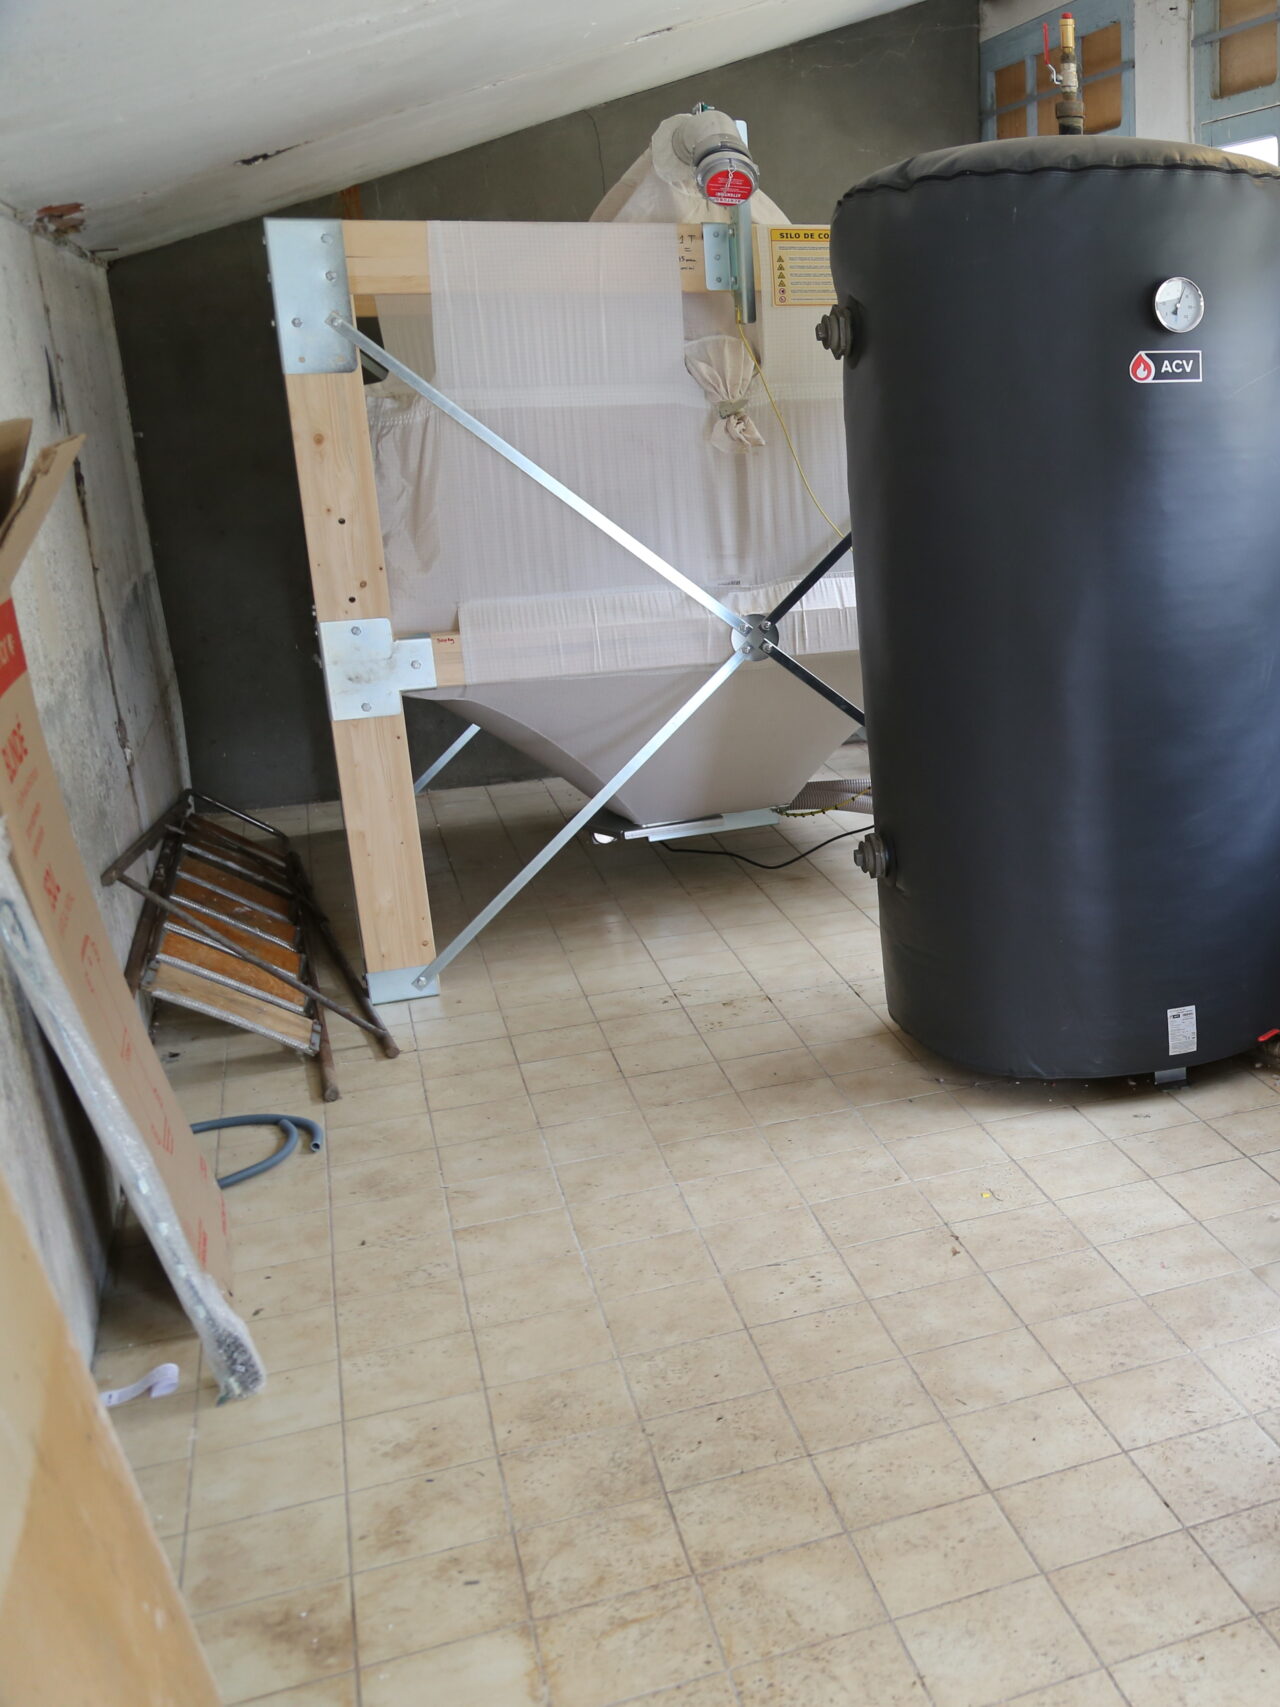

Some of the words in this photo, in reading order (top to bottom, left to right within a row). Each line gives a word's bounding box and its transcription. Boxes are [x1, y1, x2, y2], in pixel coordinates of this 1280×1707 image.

[779, 232, 801, 240] SILO
[803, 232, 815, 240] DE
[1161, 360, 1194, 373] ACV
